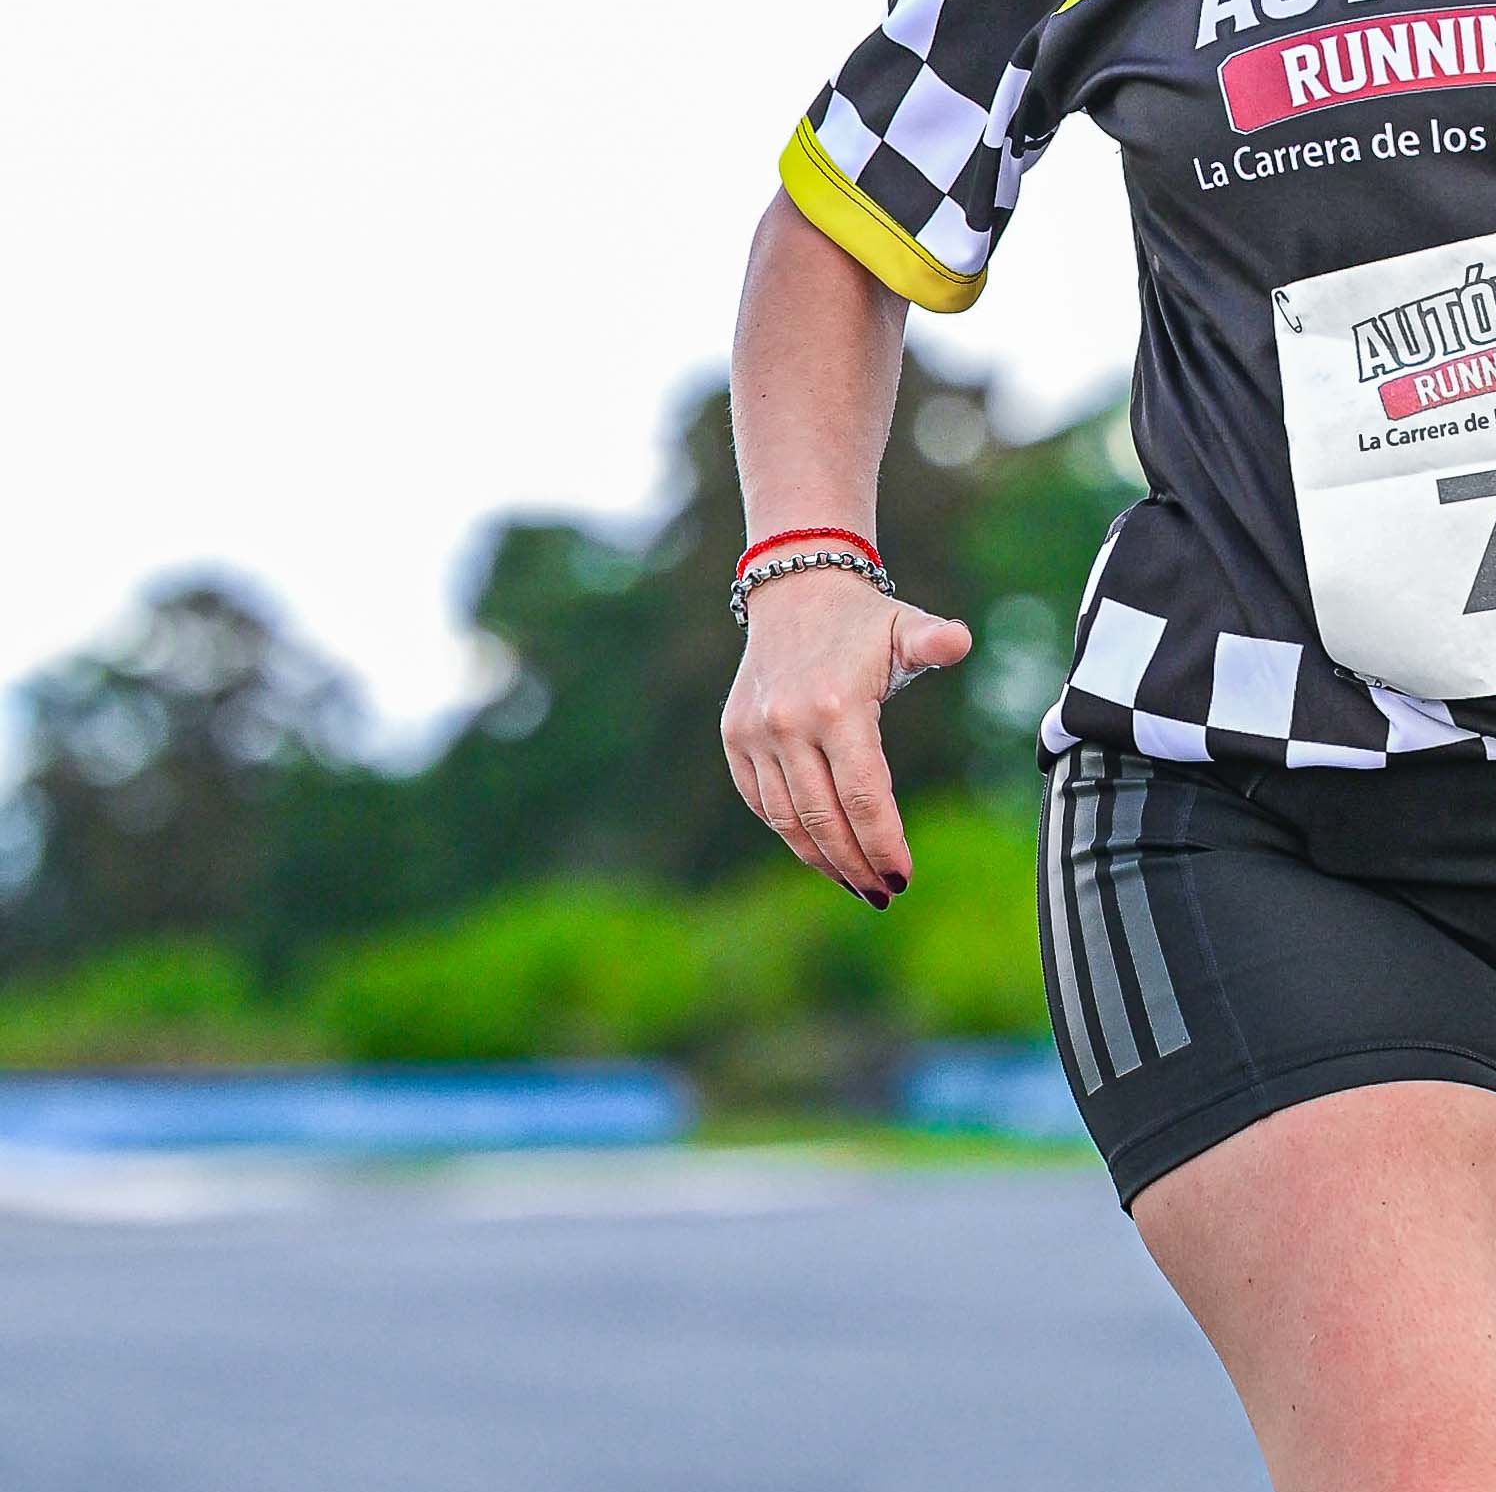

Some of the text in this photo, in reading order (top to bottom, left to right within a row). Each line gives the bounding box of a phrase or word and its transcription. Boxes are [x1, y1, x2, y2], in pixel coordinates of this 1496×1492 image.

[1193, 156, 1229, 191] La
[1233, 135, 1361, 181] Carrera
[1371, 122, 1420, 158] de
[1430, 118, 1487, 154] los
[1358, 433, 1381, 452] La
[1385, 421, 1459, 447] Carrera
[1464, 412, 1490, 433] de
